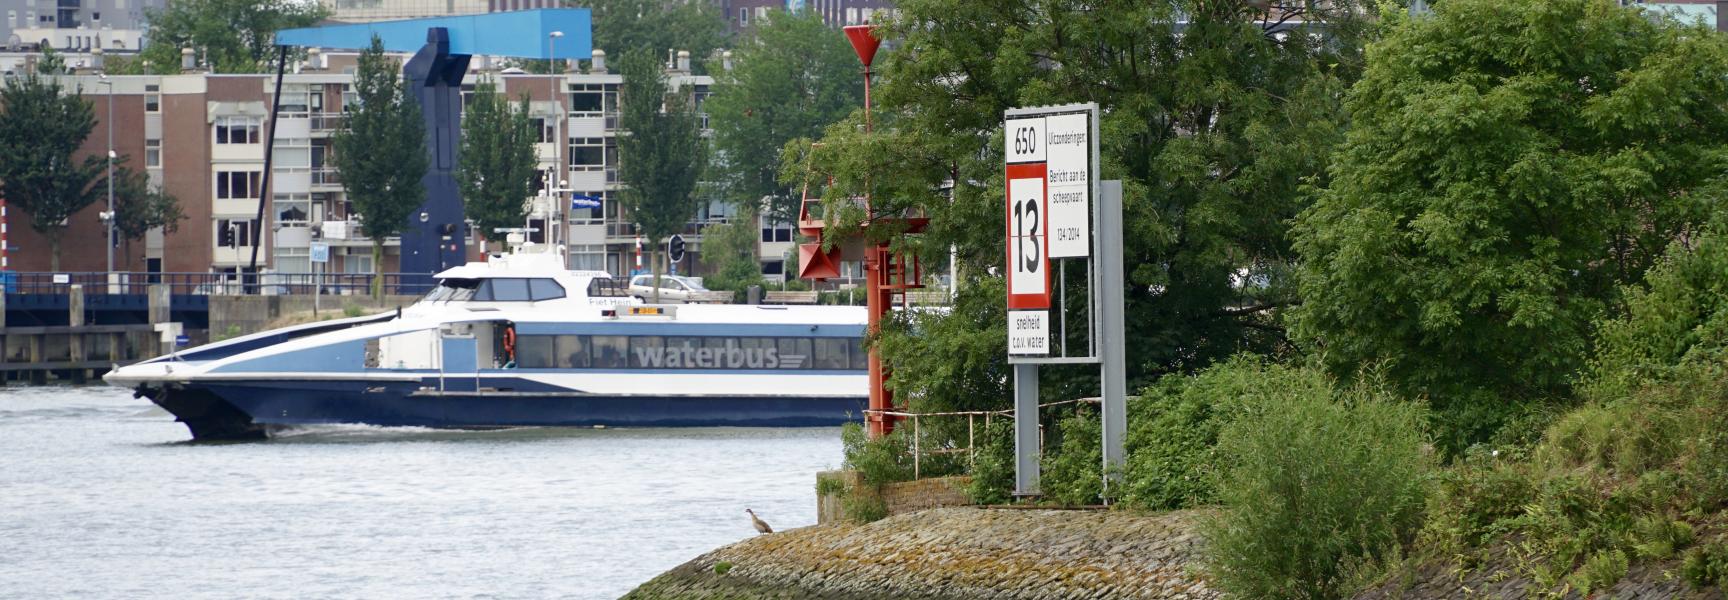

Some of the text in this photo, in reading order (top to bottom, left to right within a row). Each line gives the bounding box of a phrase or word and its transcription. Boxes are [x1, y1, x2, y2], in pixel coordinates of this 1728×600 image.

[1015, 126, 1037, 155] 650
[1049, 169, 1086, 183] Bericht aan de
[1052, 191, 1083, 206] scheepvaart
[1014, 198, 1040, 274] 13
[1016, 314, 1040, 330] snelheid
[1027, 336, 1045, 349] water
[635, 339, 779, 369] waterbus
